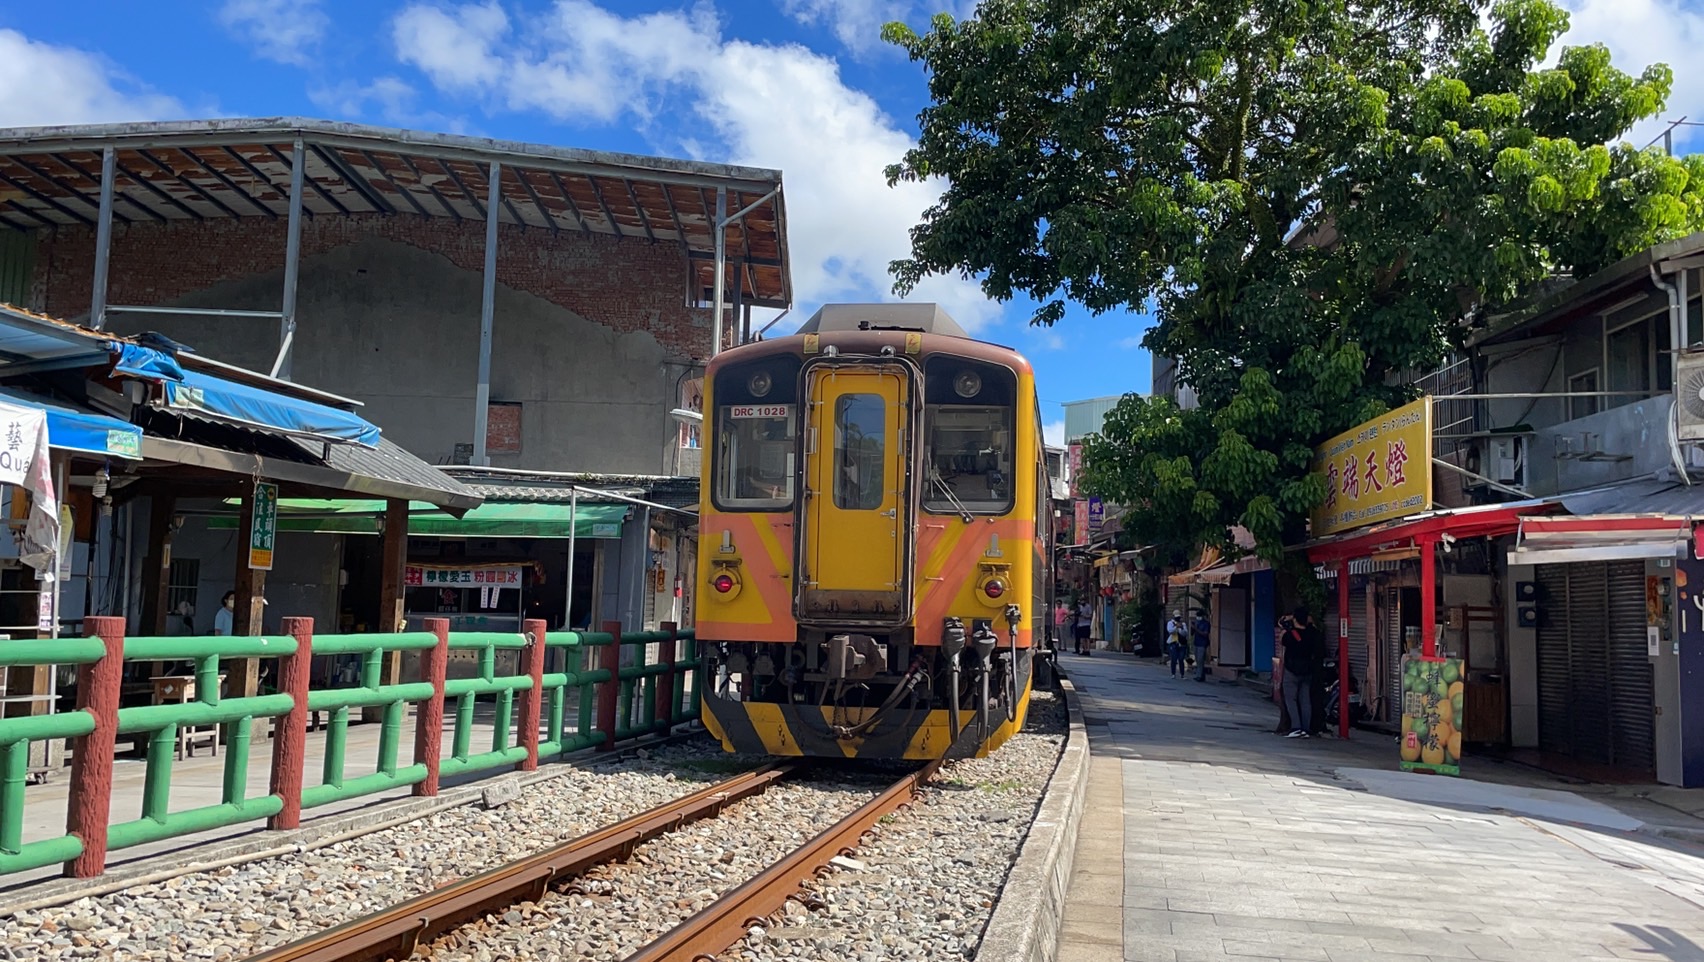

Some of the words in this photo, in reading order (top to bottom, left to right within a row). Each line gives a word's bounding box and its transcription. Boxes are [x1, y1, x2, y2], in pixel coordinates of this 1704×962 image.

[5, 421, 23, 451] 藝
[734, 408, 754, 416] DRC
[757, 407, 786, 416] 1028
[1325, 439, 1407, 509] 雲端天燈
[254, 486, 266, 547] 合法民宿
[1423, 671, 1441, 751] 蜂蜜檸檬
